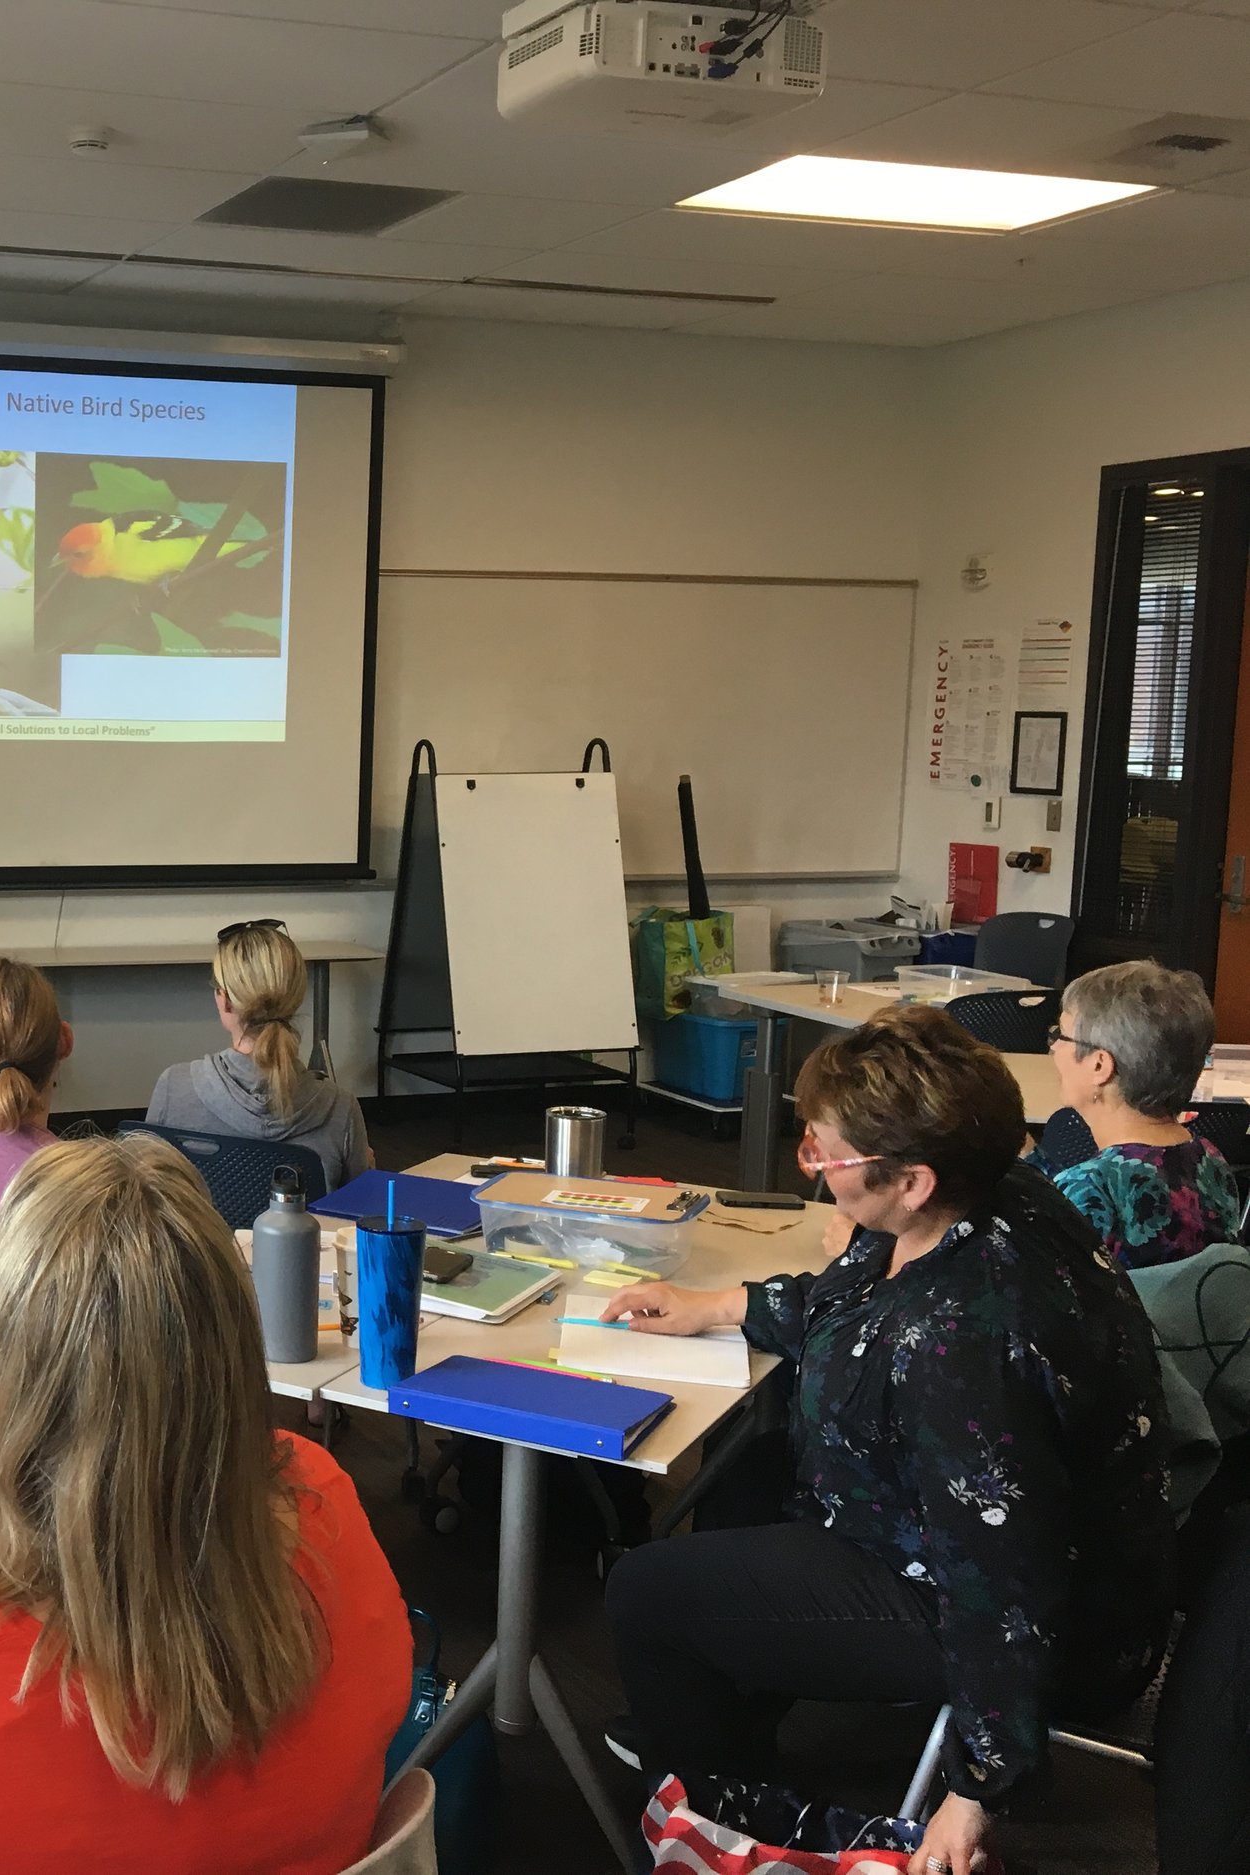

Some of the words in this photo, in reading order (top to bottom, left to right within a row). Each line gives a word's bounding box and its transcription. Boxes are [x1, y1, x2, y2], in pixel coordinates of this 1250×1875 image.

[6, 392, 75, 415] Native
[81, 396, 123, 417] Bird
[129, 398, 206, 422] Species
[929, 646, 949, 780] EMERGENCY
[6, 724, 56, 736] Solutions
[58, 725, 70, 736] to
[72, 725, 99, 736] Local
